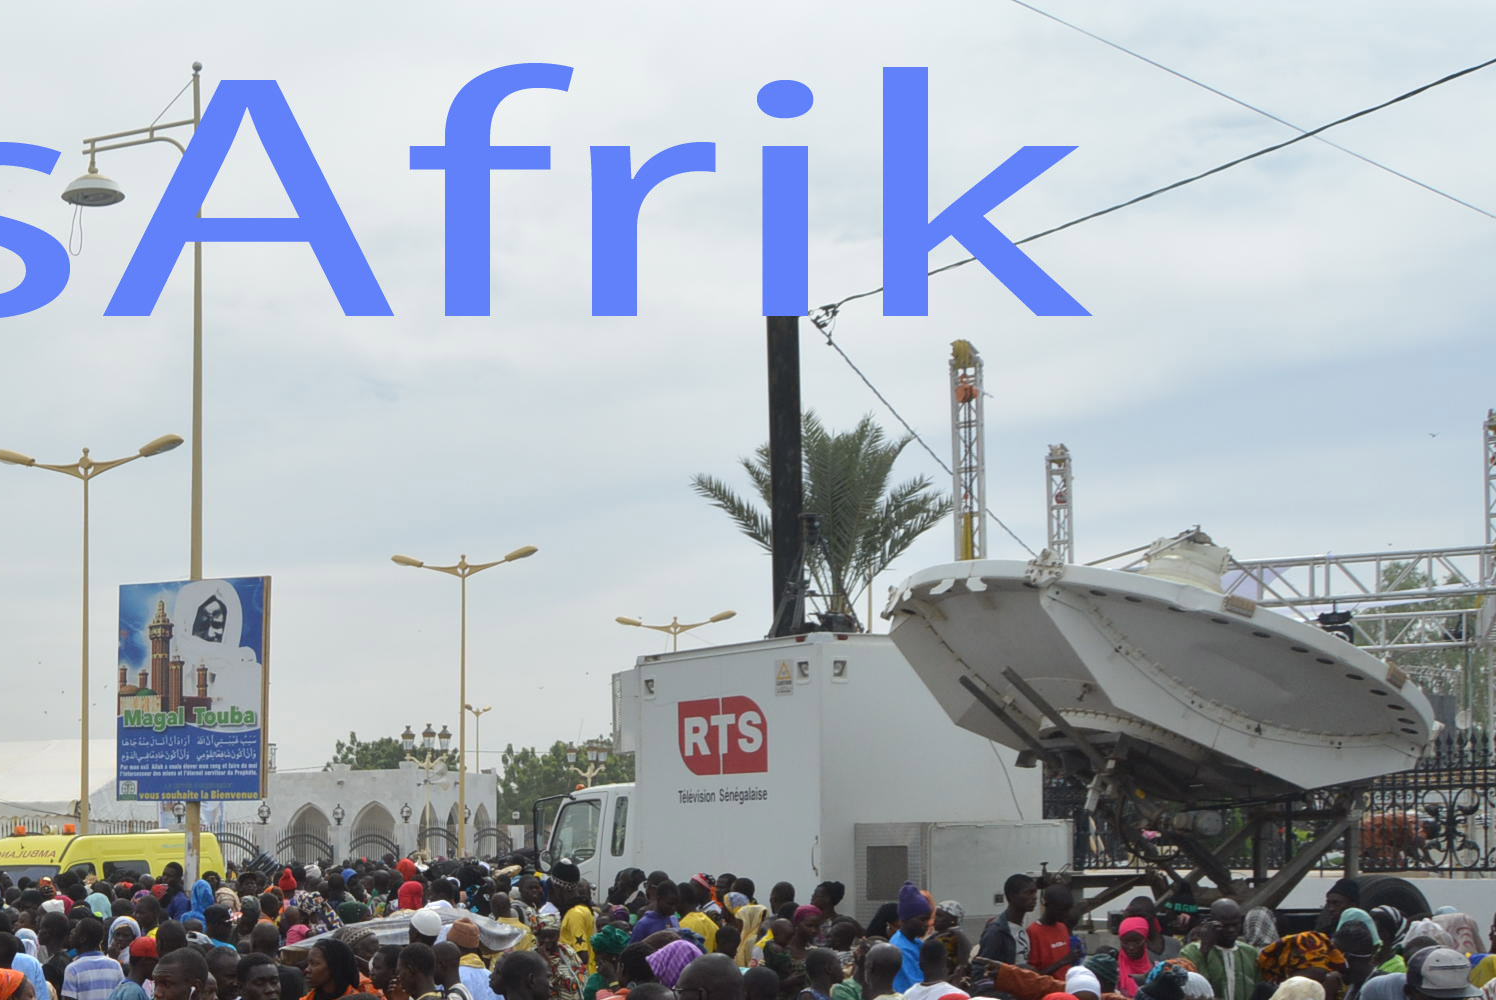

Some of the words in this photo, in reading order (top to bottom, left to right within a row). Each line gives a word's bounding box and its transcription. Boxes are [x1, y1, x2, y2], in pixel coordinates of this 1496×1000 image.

[124, 706, 185, 732] Magal
[193, 705, 256, 726] Touba
[684, 711, 763, 757] RTS
[139, 792, 160, 800] vous
[161, 789, 199, 800] souhaite
[210, 789, 258, 800] Bienvenue
